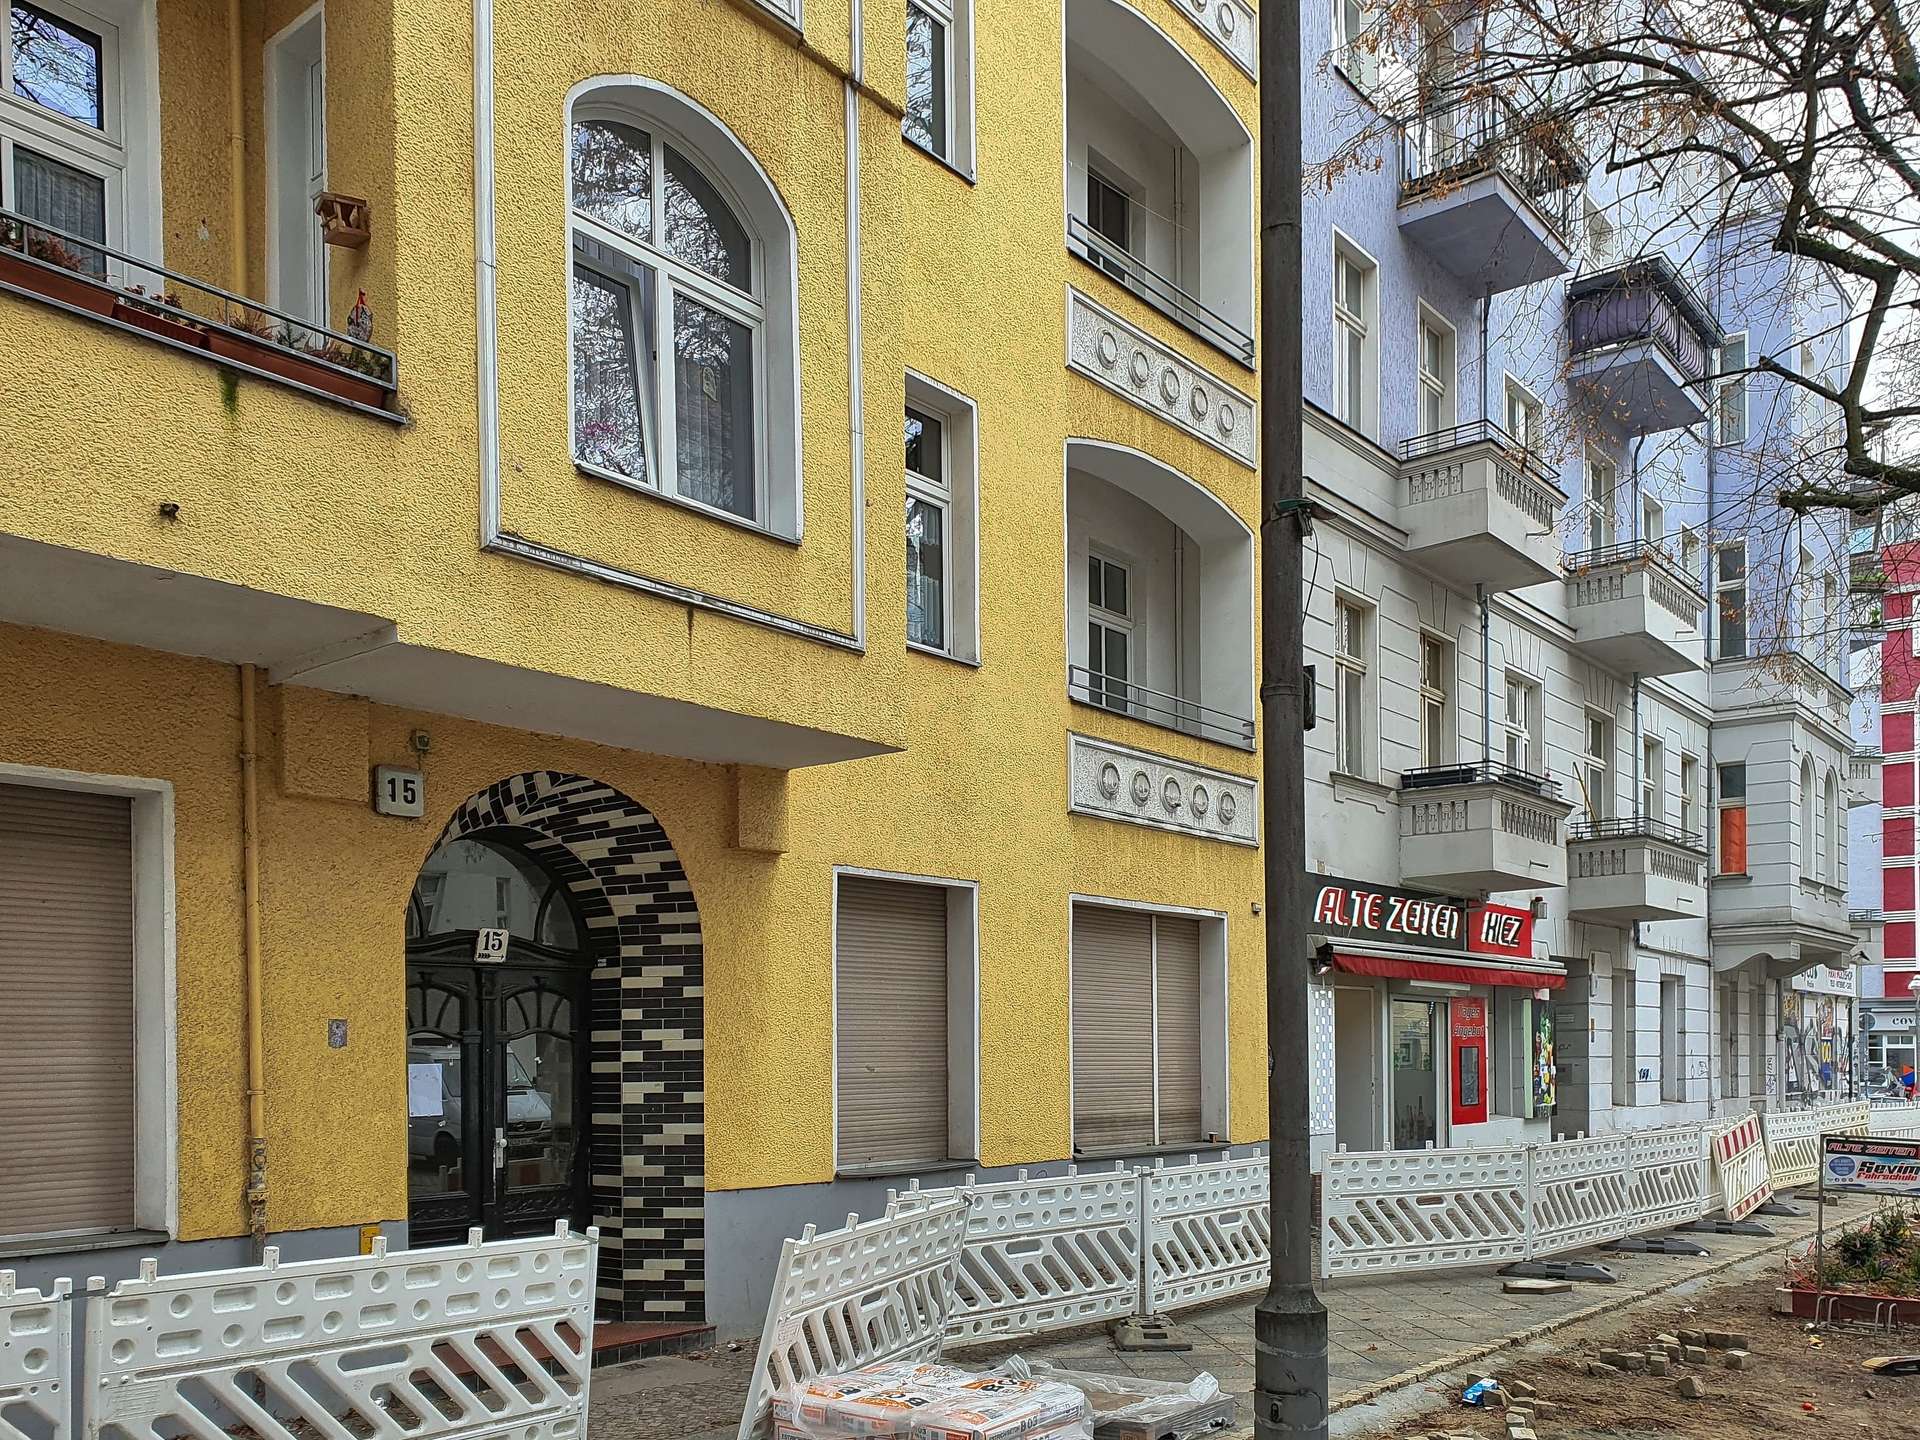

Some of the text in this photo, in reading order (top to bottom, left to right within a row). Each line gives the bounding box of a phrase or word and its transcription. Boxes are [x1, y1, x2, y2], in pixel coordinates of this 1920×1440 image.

[387, 777, 416, 805] 15
[1313, 886, 1385, 930] ALTE
[483, 930, 504, 951] 15
[1480, 911, 1524, 948] KIEZ
[1827, 1142, 1863, 1153] ALTE
[1858, 1161, 1920, 1176] Sevim
